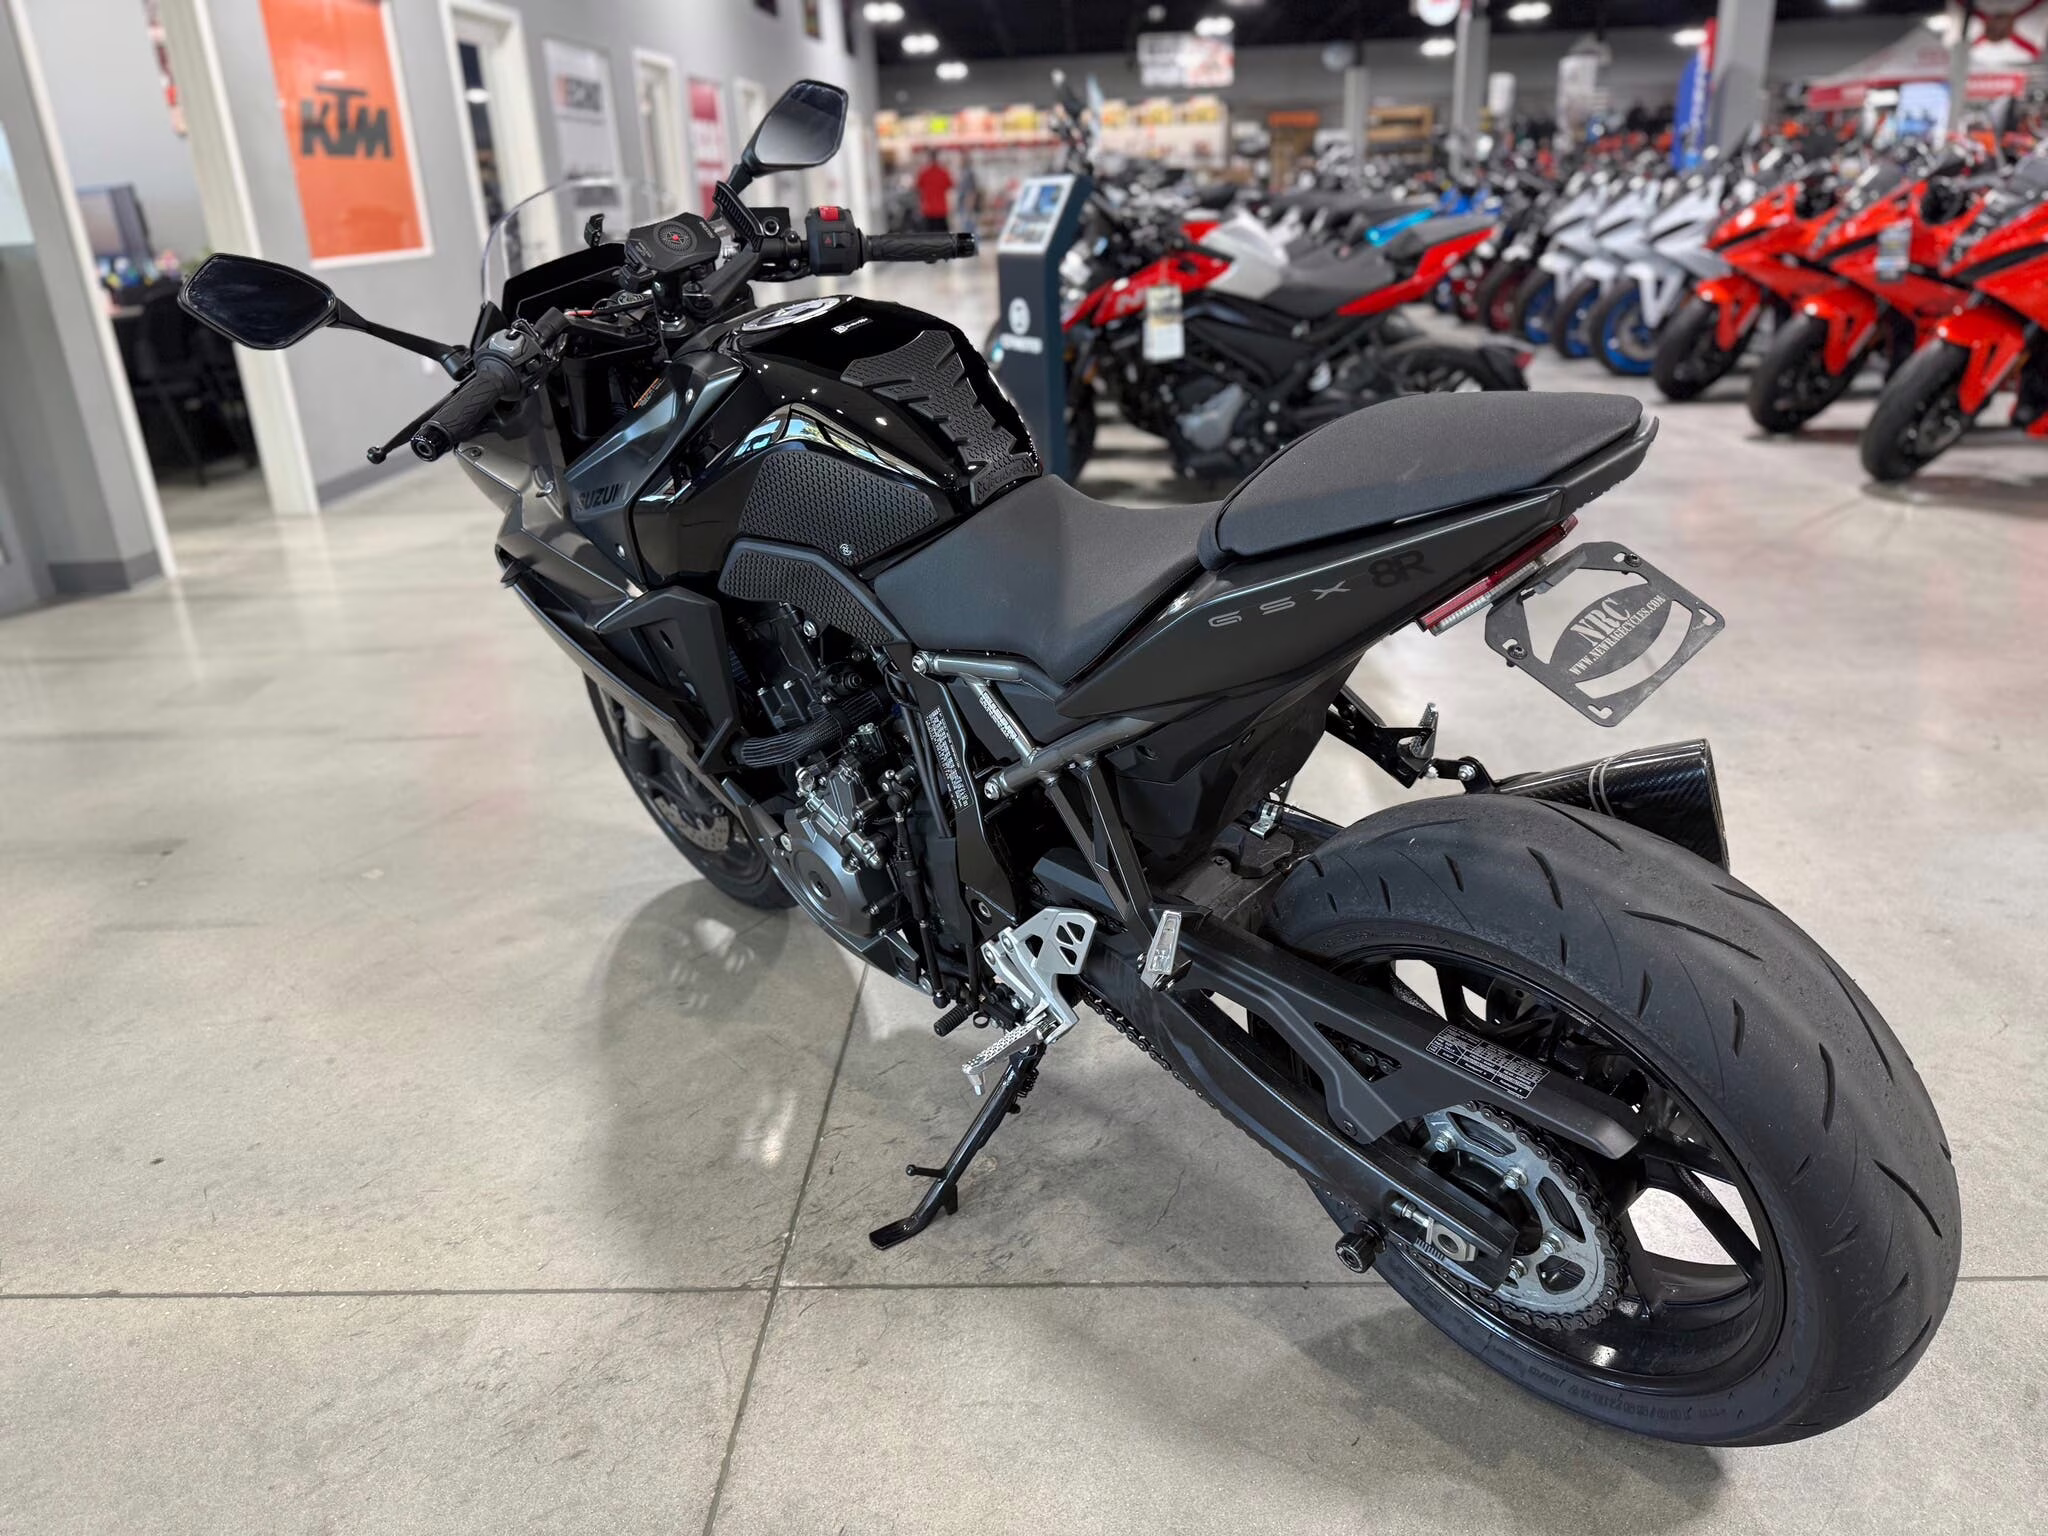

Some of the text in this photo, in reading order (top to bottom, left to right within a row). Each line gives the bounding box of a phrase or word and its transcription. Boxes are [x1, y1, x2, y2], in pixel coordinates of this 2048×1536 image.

[301, 85, 393, 159] KTM
[1367, 549, 1434, 588] 8R
[1568, 592, 1666, 676] WWW.NEWRAGECYCLES.COM
[1570, 597, 1630, 647] NRC
